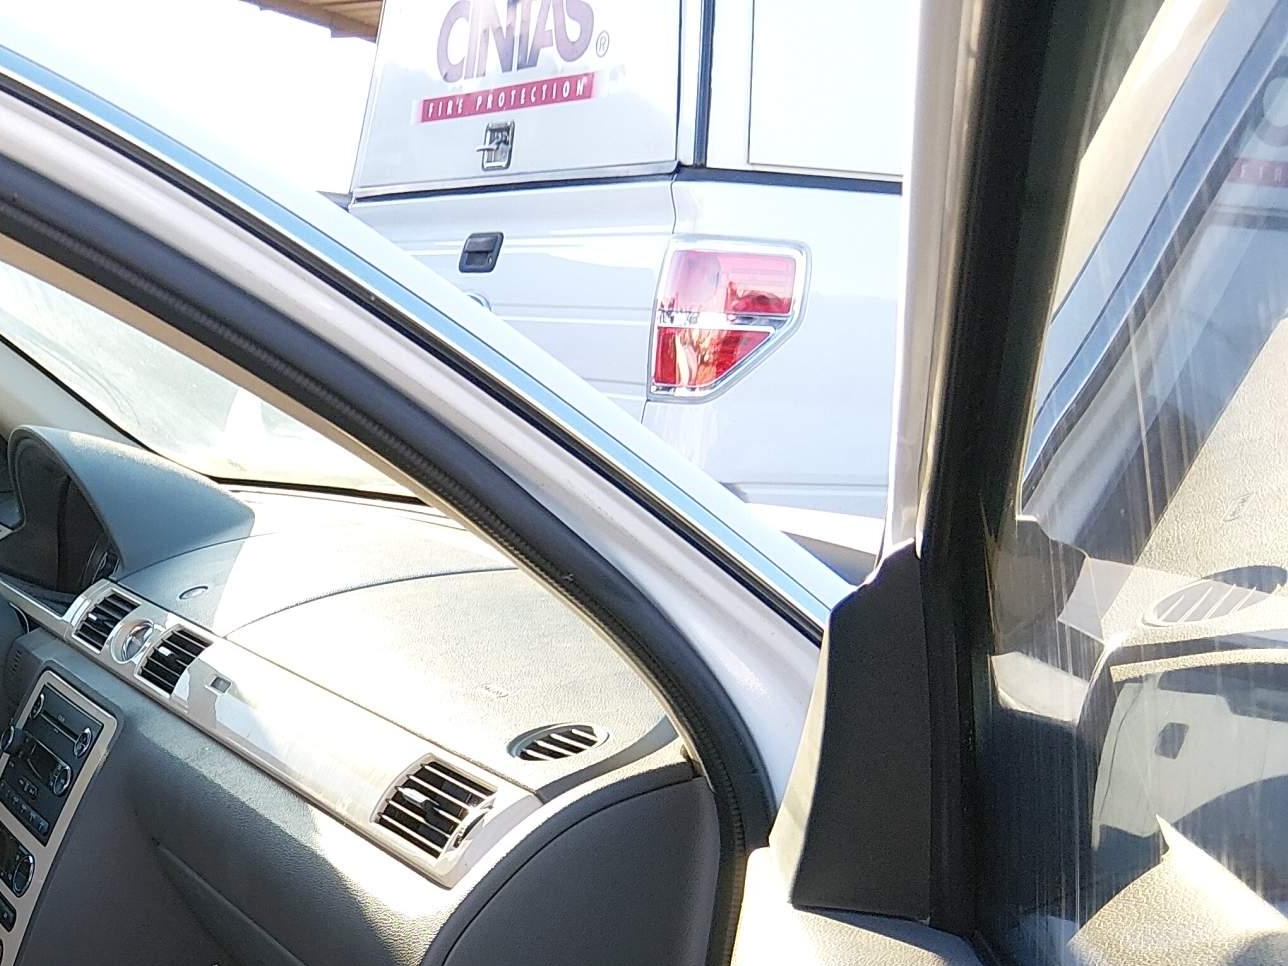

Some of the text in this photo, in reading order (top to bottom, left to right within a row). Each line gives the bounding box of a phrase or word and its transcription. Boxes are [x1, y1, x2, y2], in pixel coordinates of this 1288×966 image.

[437, 0, 595, 83] CINTAS
[427, 79, 587, 118] FIRE PROTECTION
